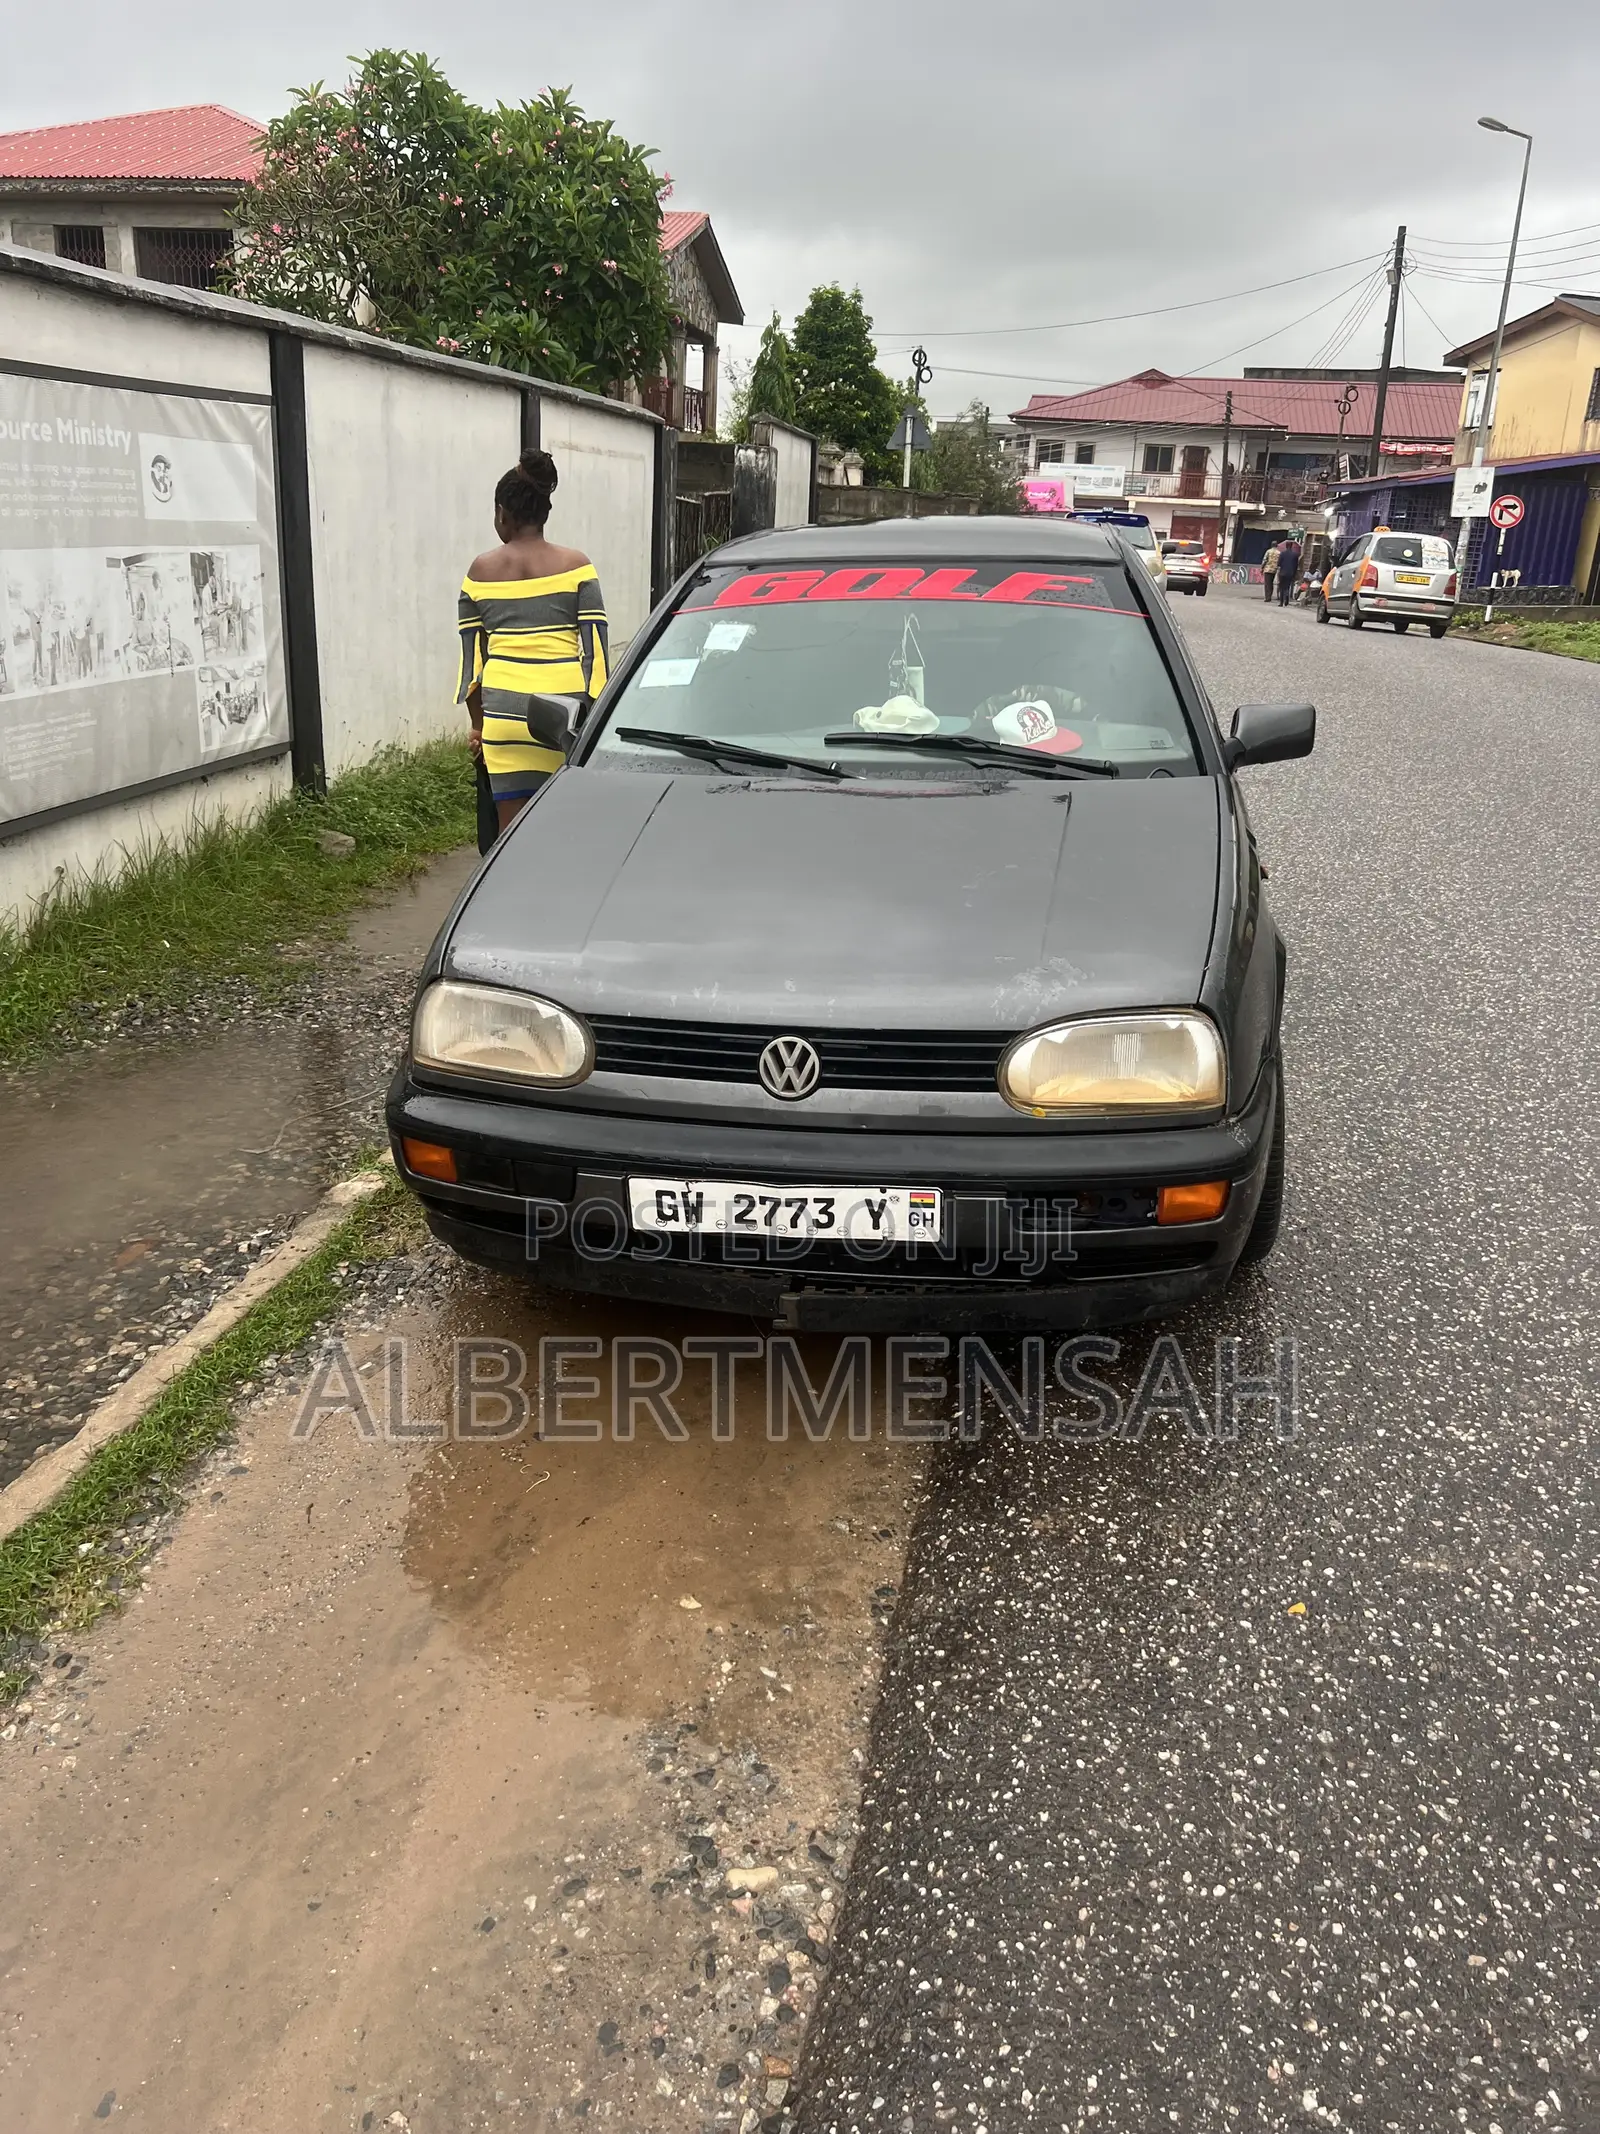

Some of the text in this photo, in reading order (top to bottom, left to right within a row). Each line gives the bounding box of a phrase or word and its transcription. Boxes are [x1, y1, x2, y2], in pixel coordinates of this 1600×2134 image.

[56, 417, 131, 455] Ministry
[713, 567, 1096, 606] GOLF
[655, 1189, 887, 1230] GW 2773 Y
[908, 1211, 935, 1228] GH
